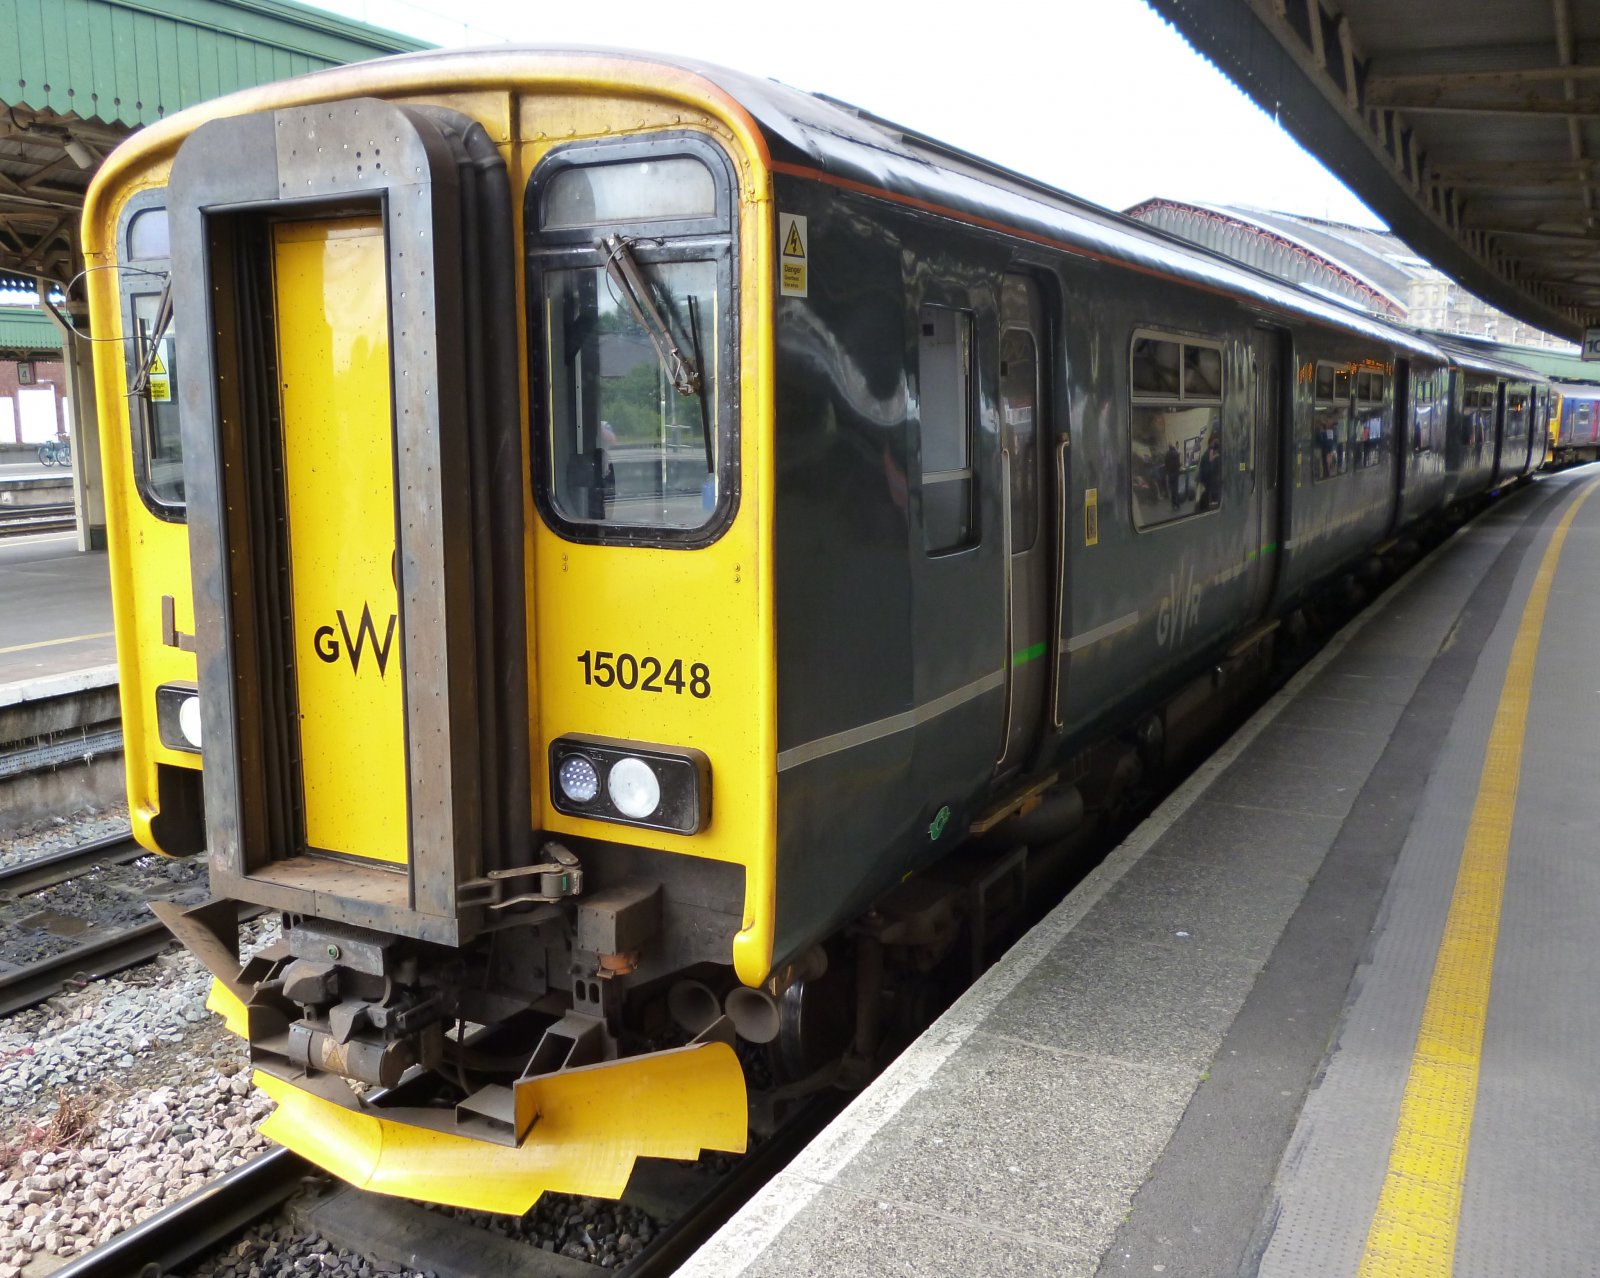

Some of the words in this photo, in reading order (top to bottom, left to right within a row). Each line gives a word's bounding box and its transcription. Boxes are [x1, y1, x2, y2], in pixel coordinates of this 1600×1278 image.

[22, 370, 27, 378] 4
[1157, 558, 1202, 652] GWR
[577, 650, 711, 699] 150248
